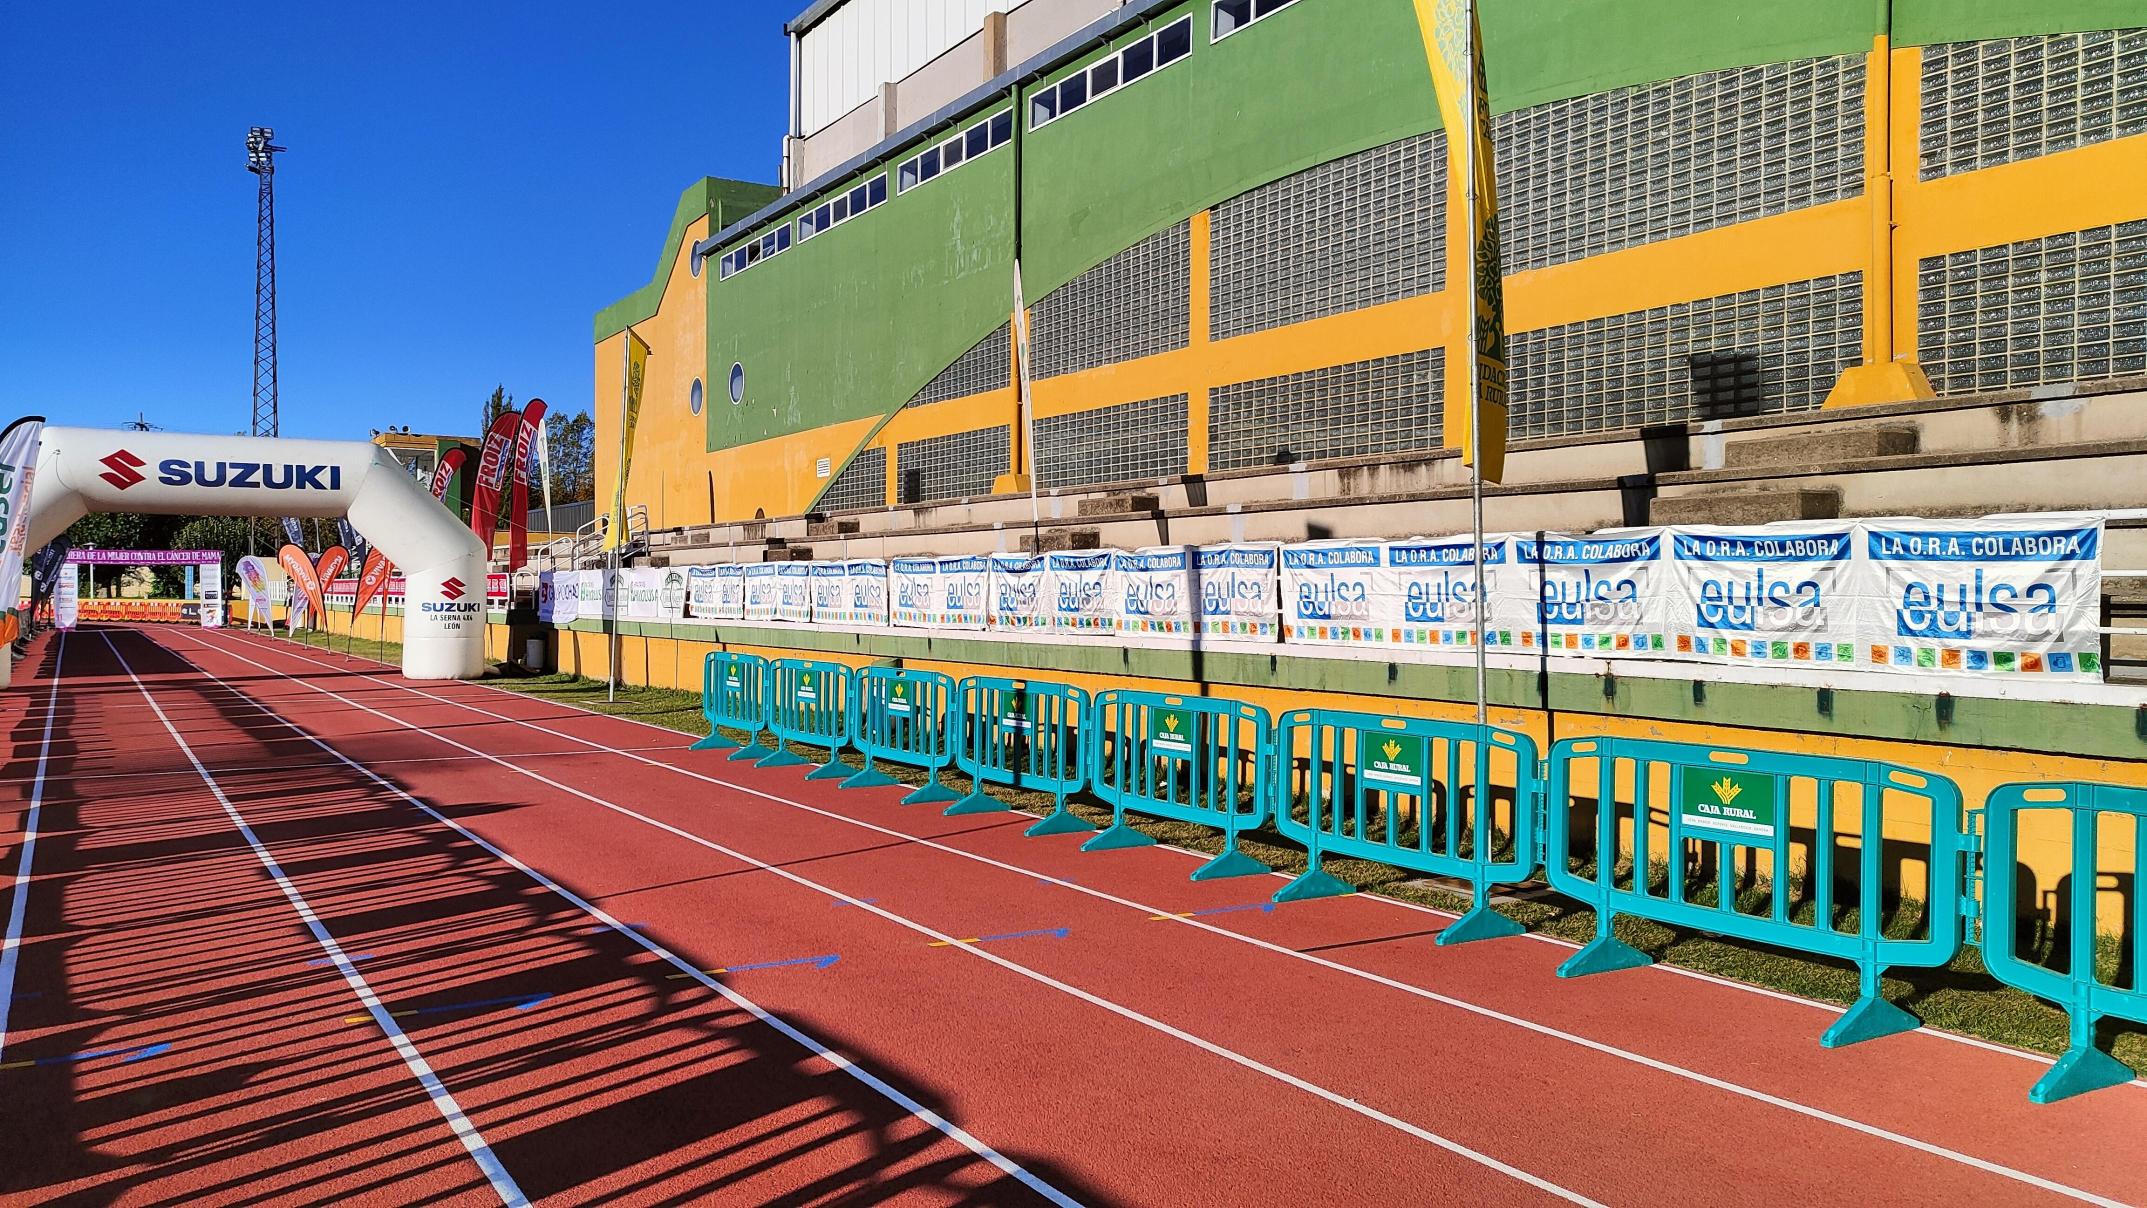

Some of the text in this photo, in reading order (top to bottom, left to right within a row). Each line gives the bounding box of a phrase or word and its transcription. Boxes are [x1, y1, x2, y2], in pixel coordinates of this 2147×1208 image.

[478, 432, 504, 488] FROIZ
[515, 421, 533, 484] FROIZ
[158, 459, 341, 490] SUZUKI
[432, 461, 451, 498] ROIZ
[1196, 552, 1269, 566] LA O.R.A. COLABORA
[1288, 550, 1374, 565] LA O.R.A. COLABORA
[1395, 546, 1498, 563] LA O.R.A. COLABRA
[1524, 540, 1650, 560] LA O.R.A. COLABORA
[1683, 537, 1839, 558] LA O.R.A. COLABORA
[1881, 535, 2081, 556] LA O.R.A. COLABORA
[1147, 556, 1182, 568] COLABORA
[900, 577, 930, 606] eulsa
[947, 576, 980, 608] eulsa
[1000, 577, 1037, 609] eulsa
[1058, 574, 1103, 610] eulsa
[1126, 576, 1177, 612] eulsa
[1204, 572, 1263, 613] eulsa
[1299, 572, 1369, 618] eulsa
[1406, 570, 1491, 619] eulsa
[1539, 568, 1642, 623] eulsa
[1698, 568, 1825, 628] eulsa
[1901, 568, 2060, 636] eulsa
[421, 602, 480, 613] SUZUKI
[444, 622, 461, 630] LEÓN
[1373, 760, 1411, 773] CAJA RURAL
[1697, 803, 1757, 820] CAJA RURAL
